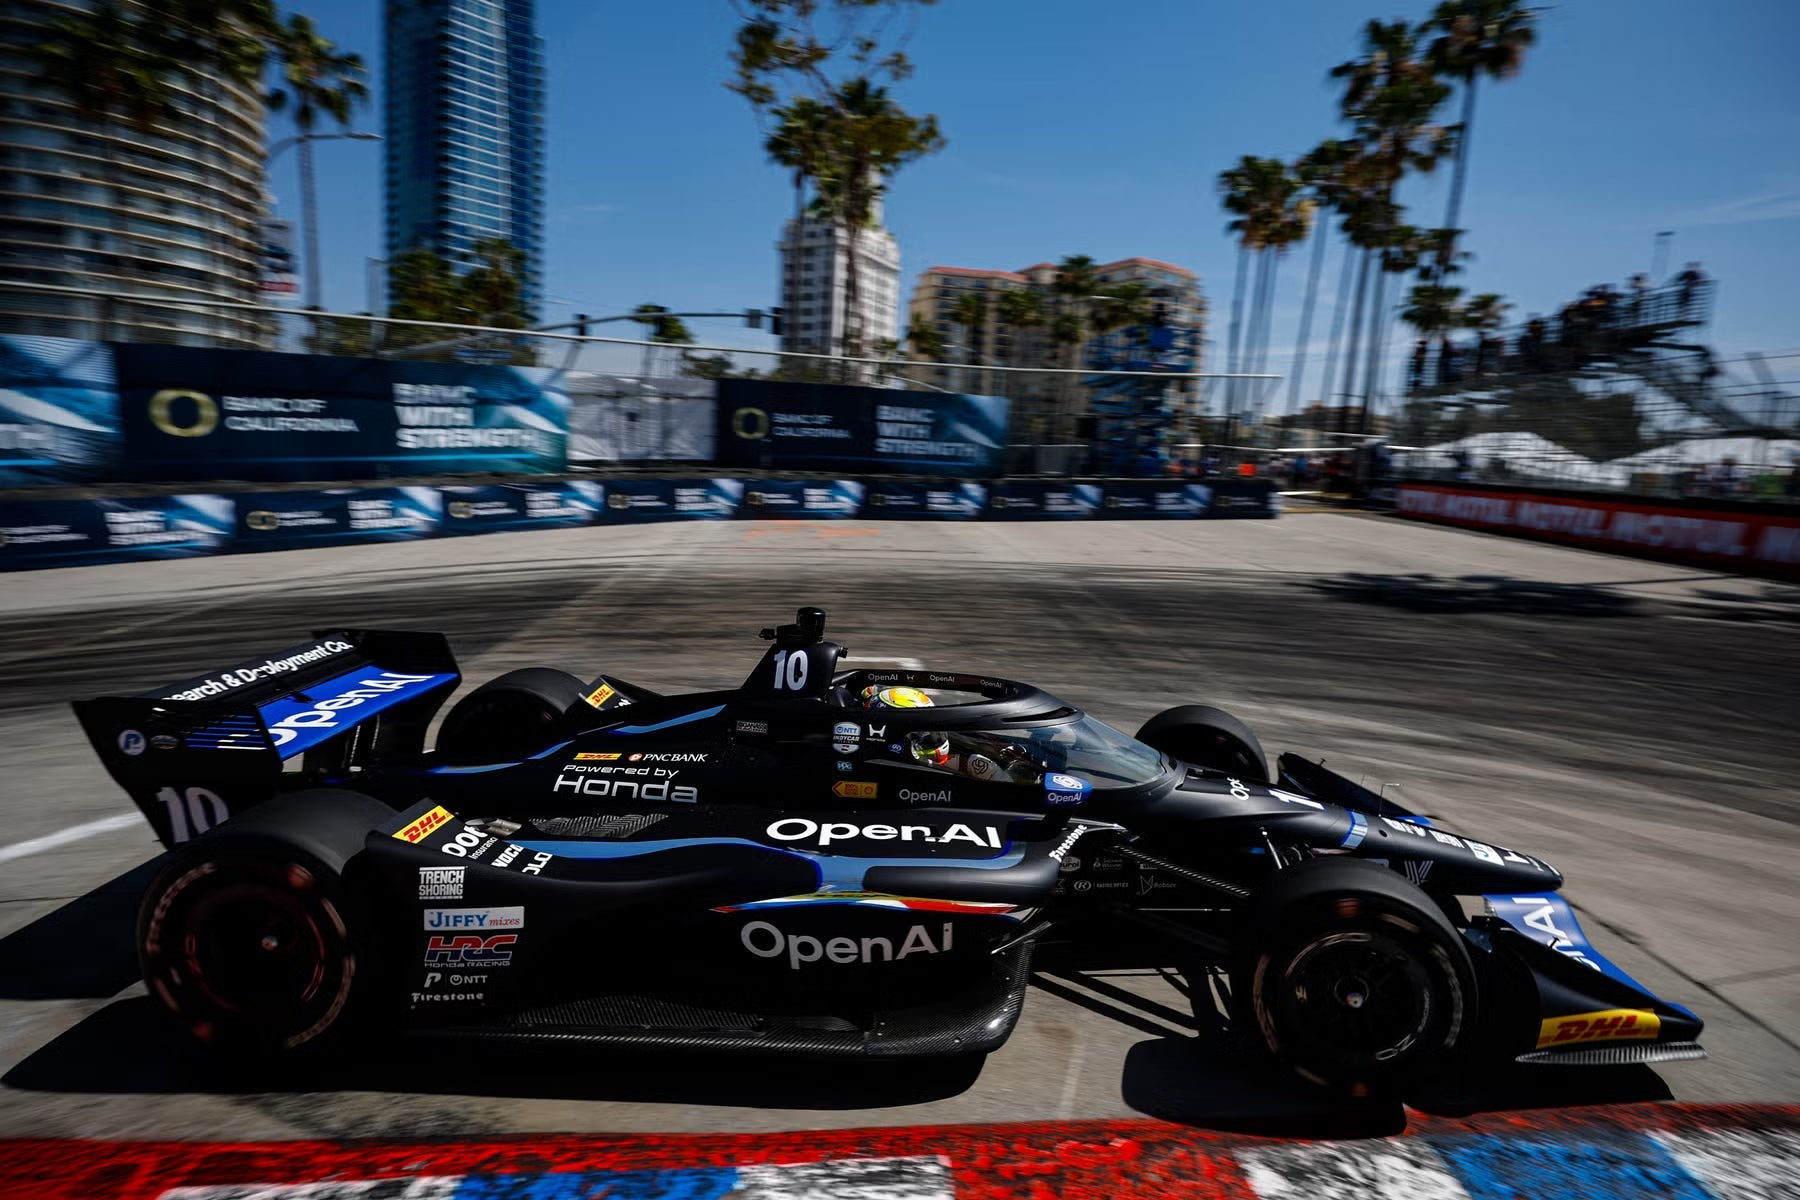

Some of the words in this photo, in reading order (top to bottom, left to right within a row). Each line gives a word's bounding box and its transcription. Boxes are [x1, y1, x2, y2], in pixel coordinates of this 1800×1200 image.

[773, 649, 809, 691] 10
[162, 680, 229, 702] earch
[221, 673, 245, 688] &
[867, 673, 899, 682] OpenAI
[929, 674, 955, 683] OpenAI
[980, 679, 1002, 689] OpenAI
[592, 688, 610, 703] DHL
[562, 764, 650, 777] Powered
[653, 767, 680, 780] by
[552, 774, 698, 804] Honda
[899, 788, 952, 804] OpenAI
[1048, 792, 1082, 804] OpenAI
[154, 786, 231, 844] 10
[403, 811, 447, 843] DHL
[766, 818, 1002, 848] OpenAI
[1048, 824, 1088, 863] Firestone
[419, 870, 464, 885] TRENCH
[418, 884, 463, 896] SHORING
[489, 917, 520, 926] mixes
[424, 934, 518, 962] HRC
[740, 920, 953, 970] OpenAI
[464, 975, 488, 984] NTT
[410, 992, 485, 1003] Firestone
[1552, 1015, 1644, 1042] DHL
